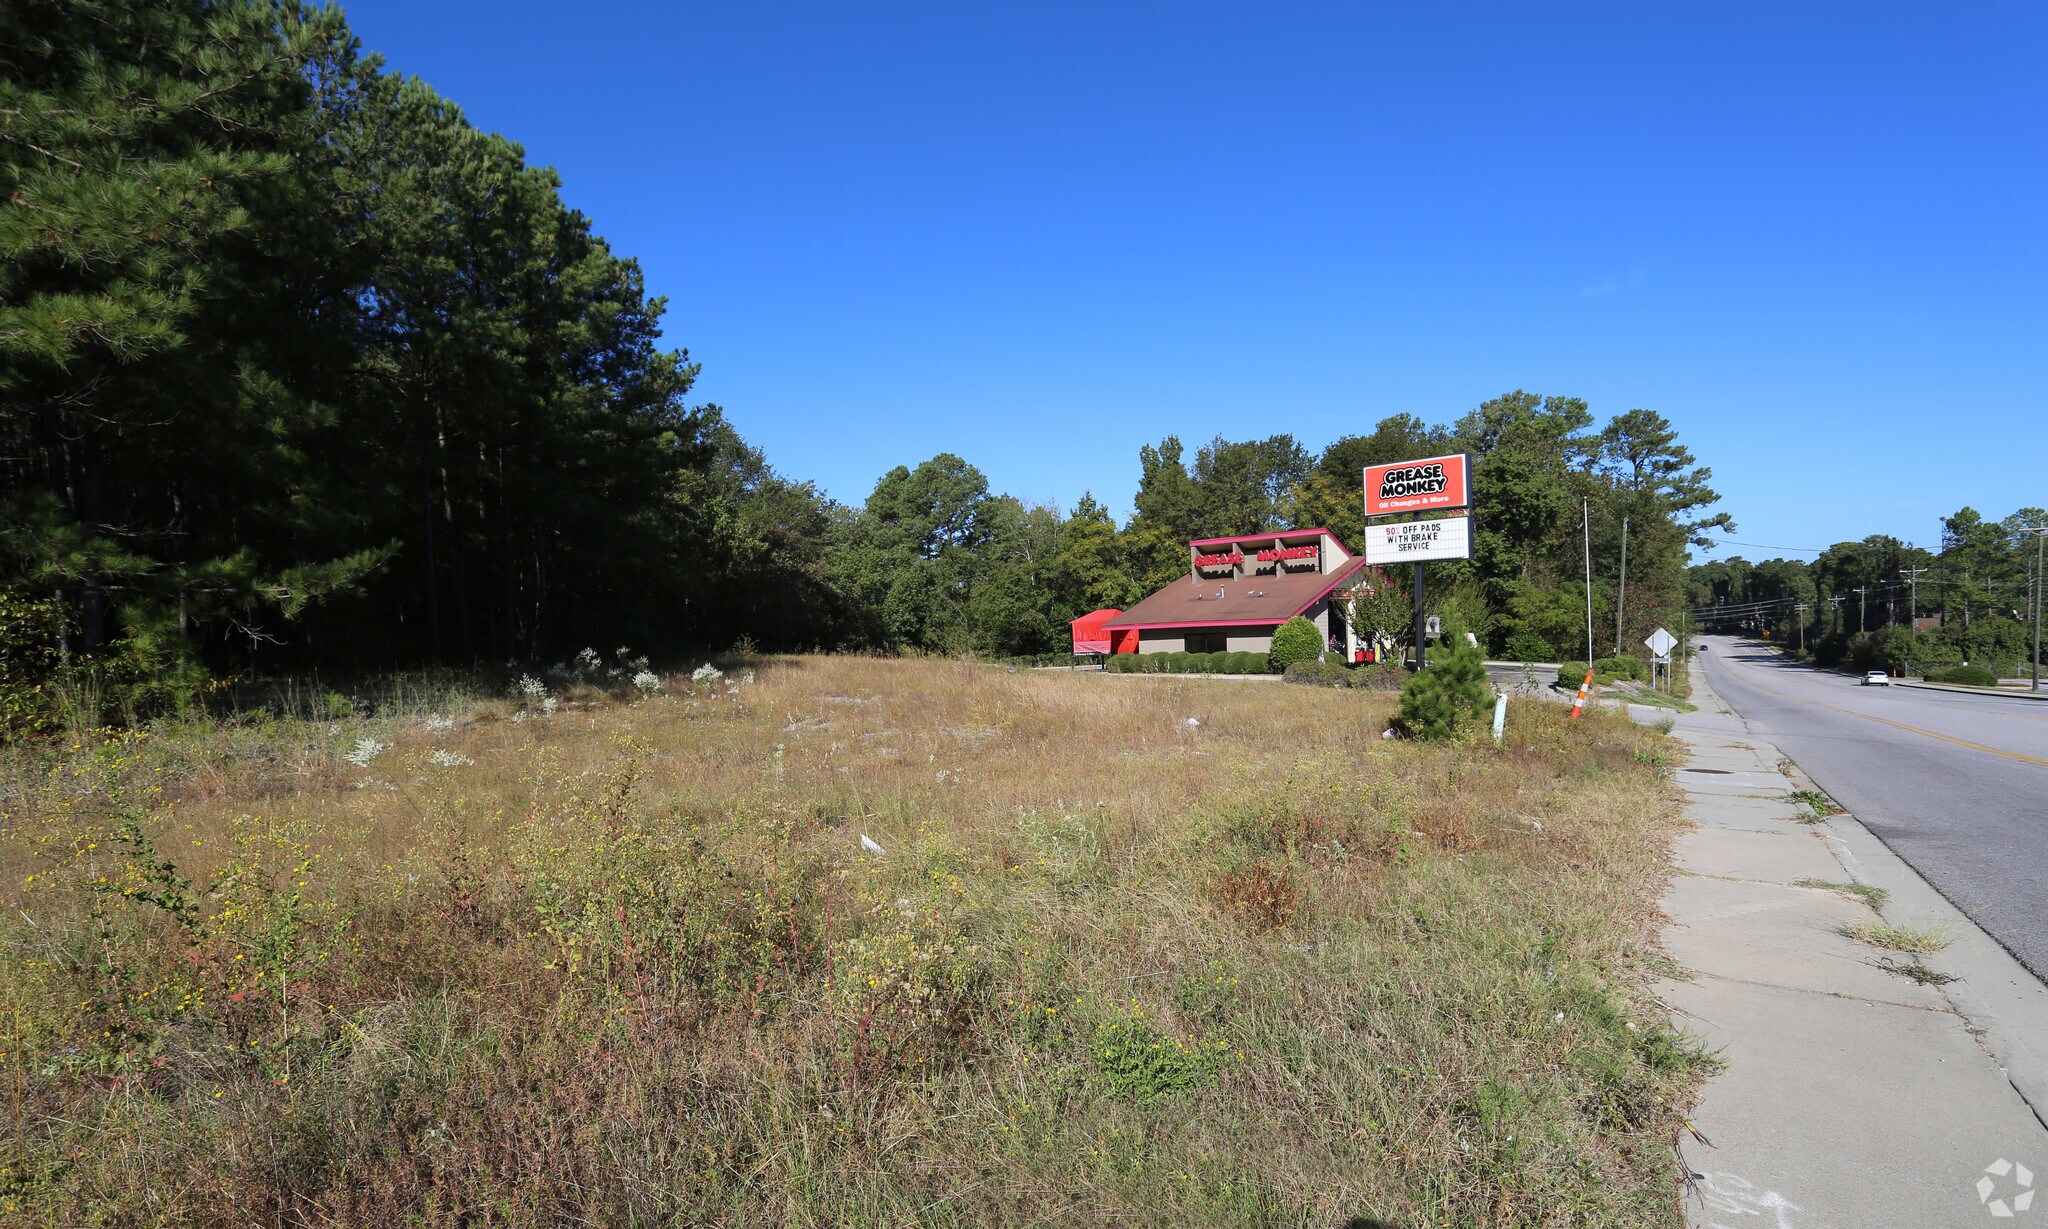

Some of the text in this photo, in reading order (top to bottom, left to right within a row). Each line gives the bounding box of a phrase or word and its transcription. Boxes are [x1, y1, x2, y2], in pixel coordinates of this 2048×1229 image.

[1385, 464, 1442, 484] GREASE
[1381, 478, 1446, 497] MONKEY
[1390, 499, 1420, 508] Changes
[1403, 525, 1417, 535] OFF
[1421, 523, 1441, 532] PADS
[1388, 532, 1438, 544] WITH BRAKE
[1399, 542, 1429, 551] SERVICE
[1195, 545, 1318, 567] GREASE MONKEY
